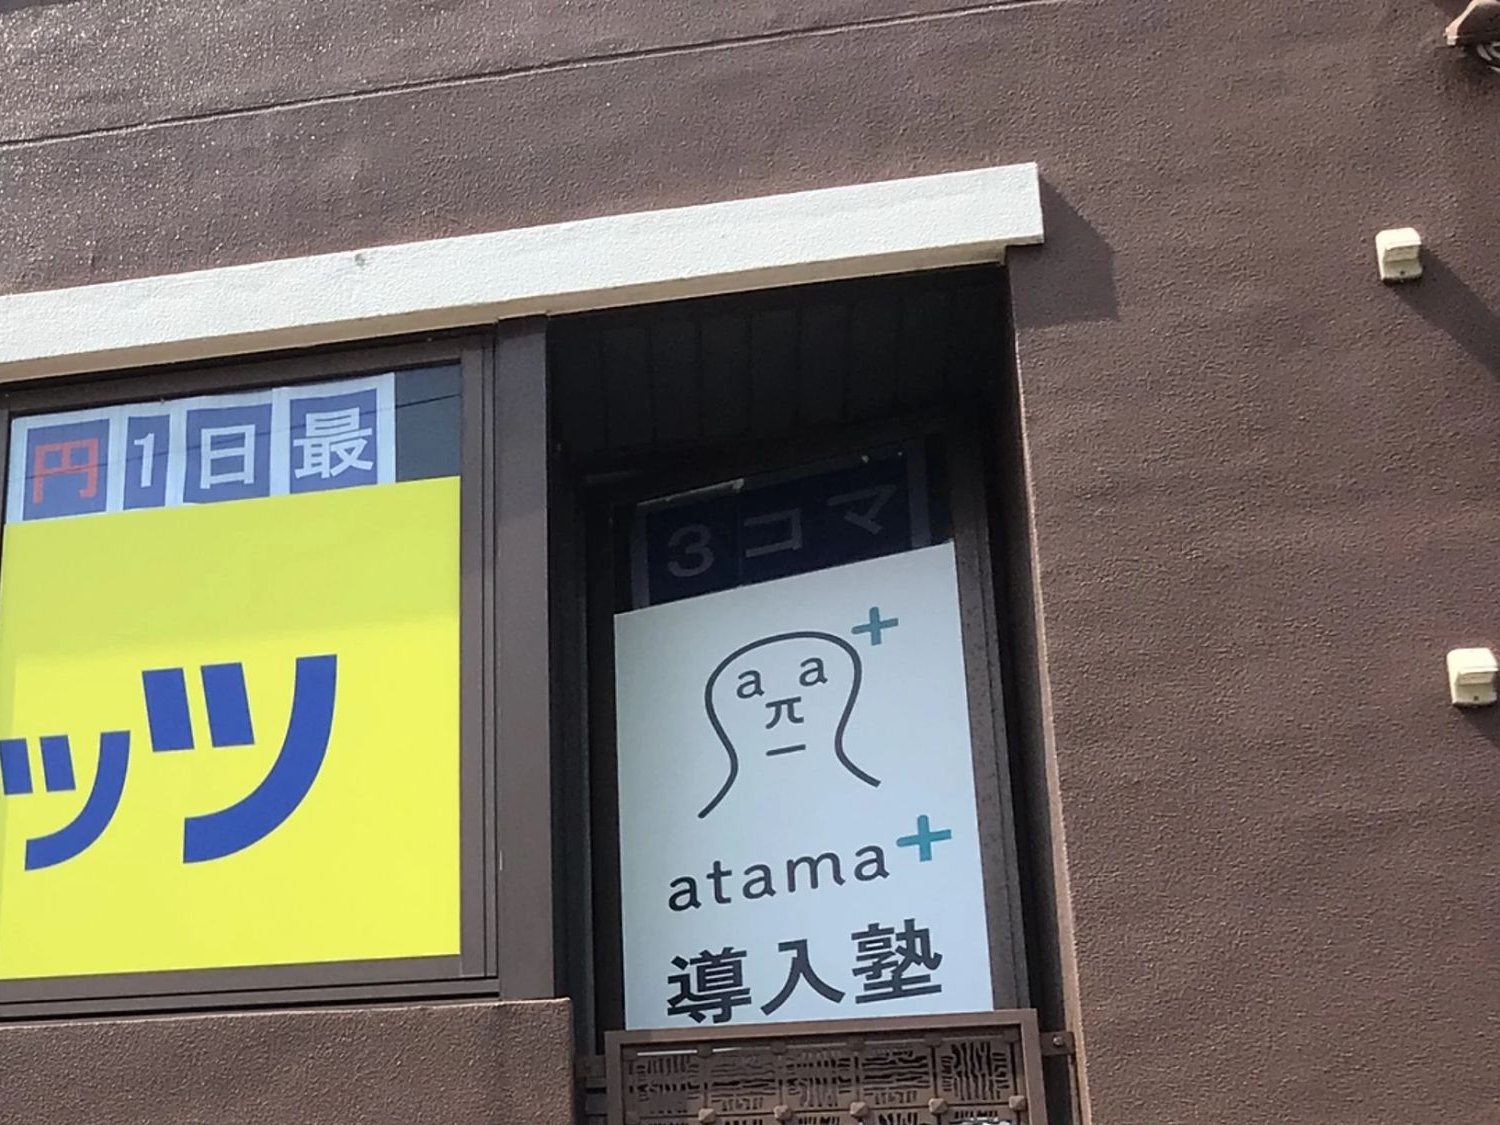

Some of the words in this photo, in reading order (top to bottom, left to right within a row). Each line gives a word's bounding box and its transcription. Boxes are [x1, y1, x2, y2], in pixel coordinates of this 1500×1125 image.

[32, 407, 374, 504] 円1日最
[667, 918, 943, 1024] 導入塾
